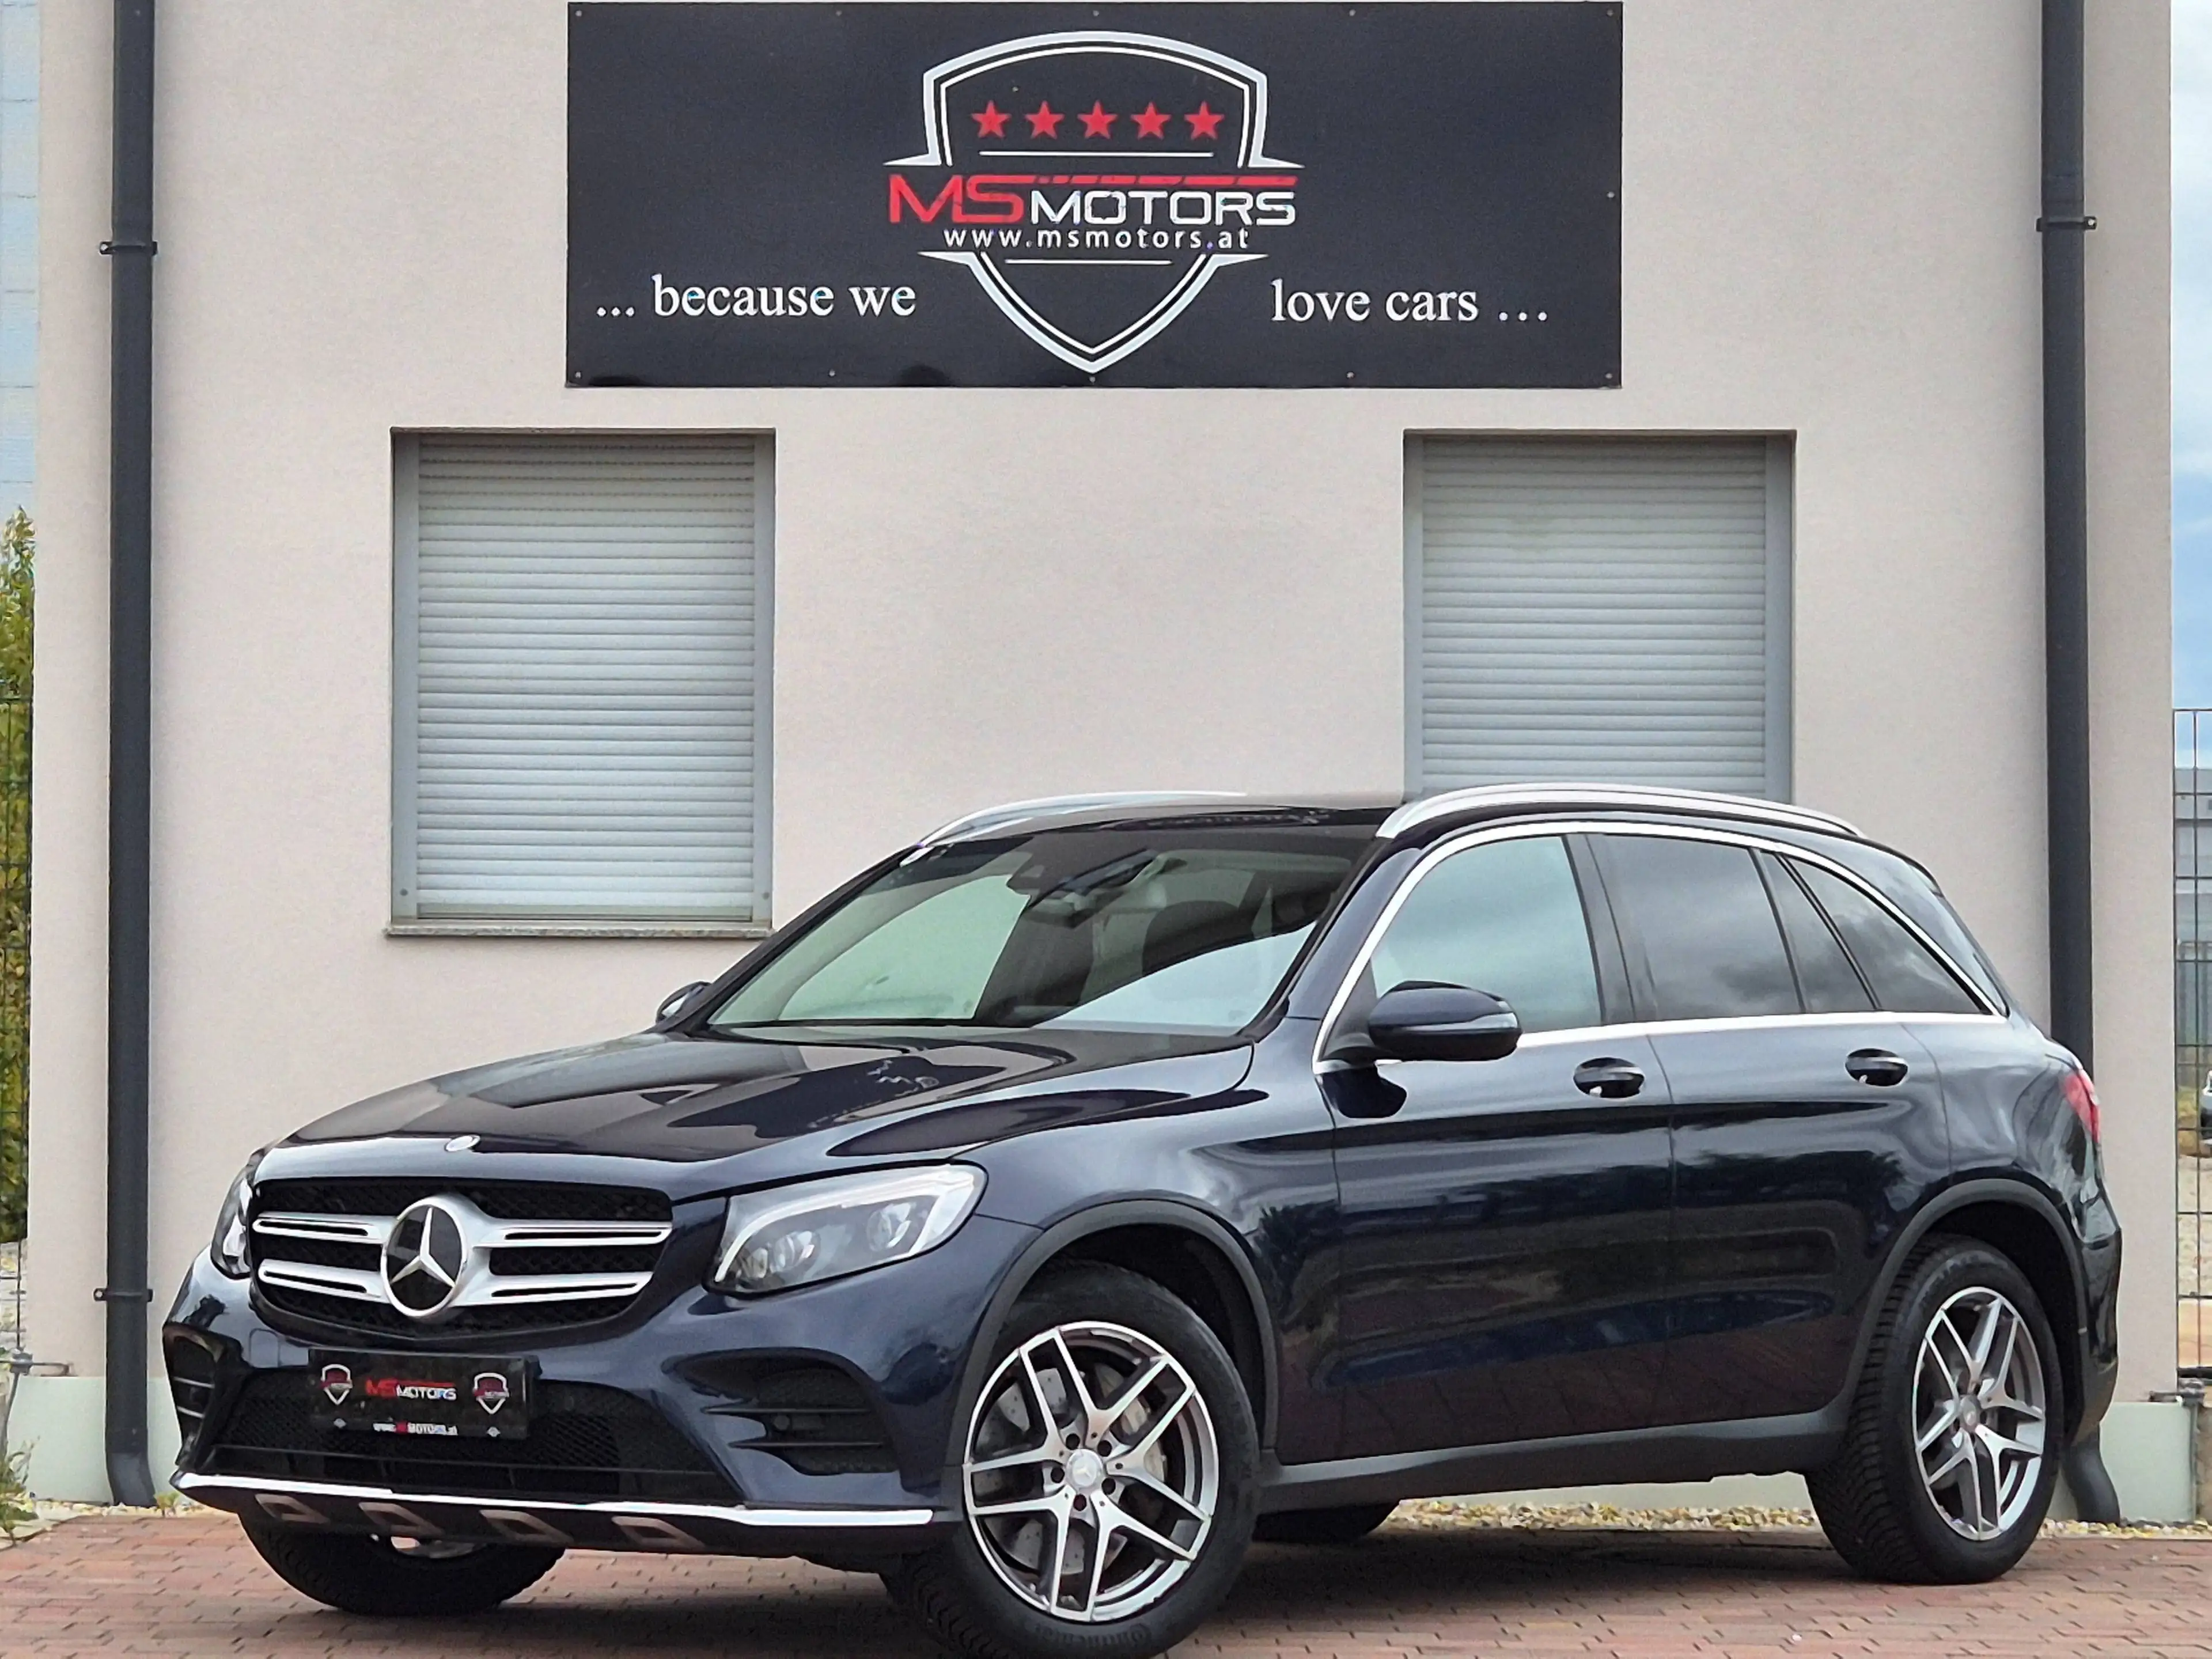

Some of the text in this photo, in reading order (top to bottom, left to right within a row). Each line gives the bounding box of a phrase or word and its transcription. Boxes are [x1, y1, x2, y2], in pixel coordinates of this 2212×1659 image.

[943, 228, 1249, 249] www.msmotors.at
[650, 272, 835, 317] because
[848, 286, 916, 317] we
[1270, 278, 1371, 322] love
[1385, 289, 1479, 322] cars
